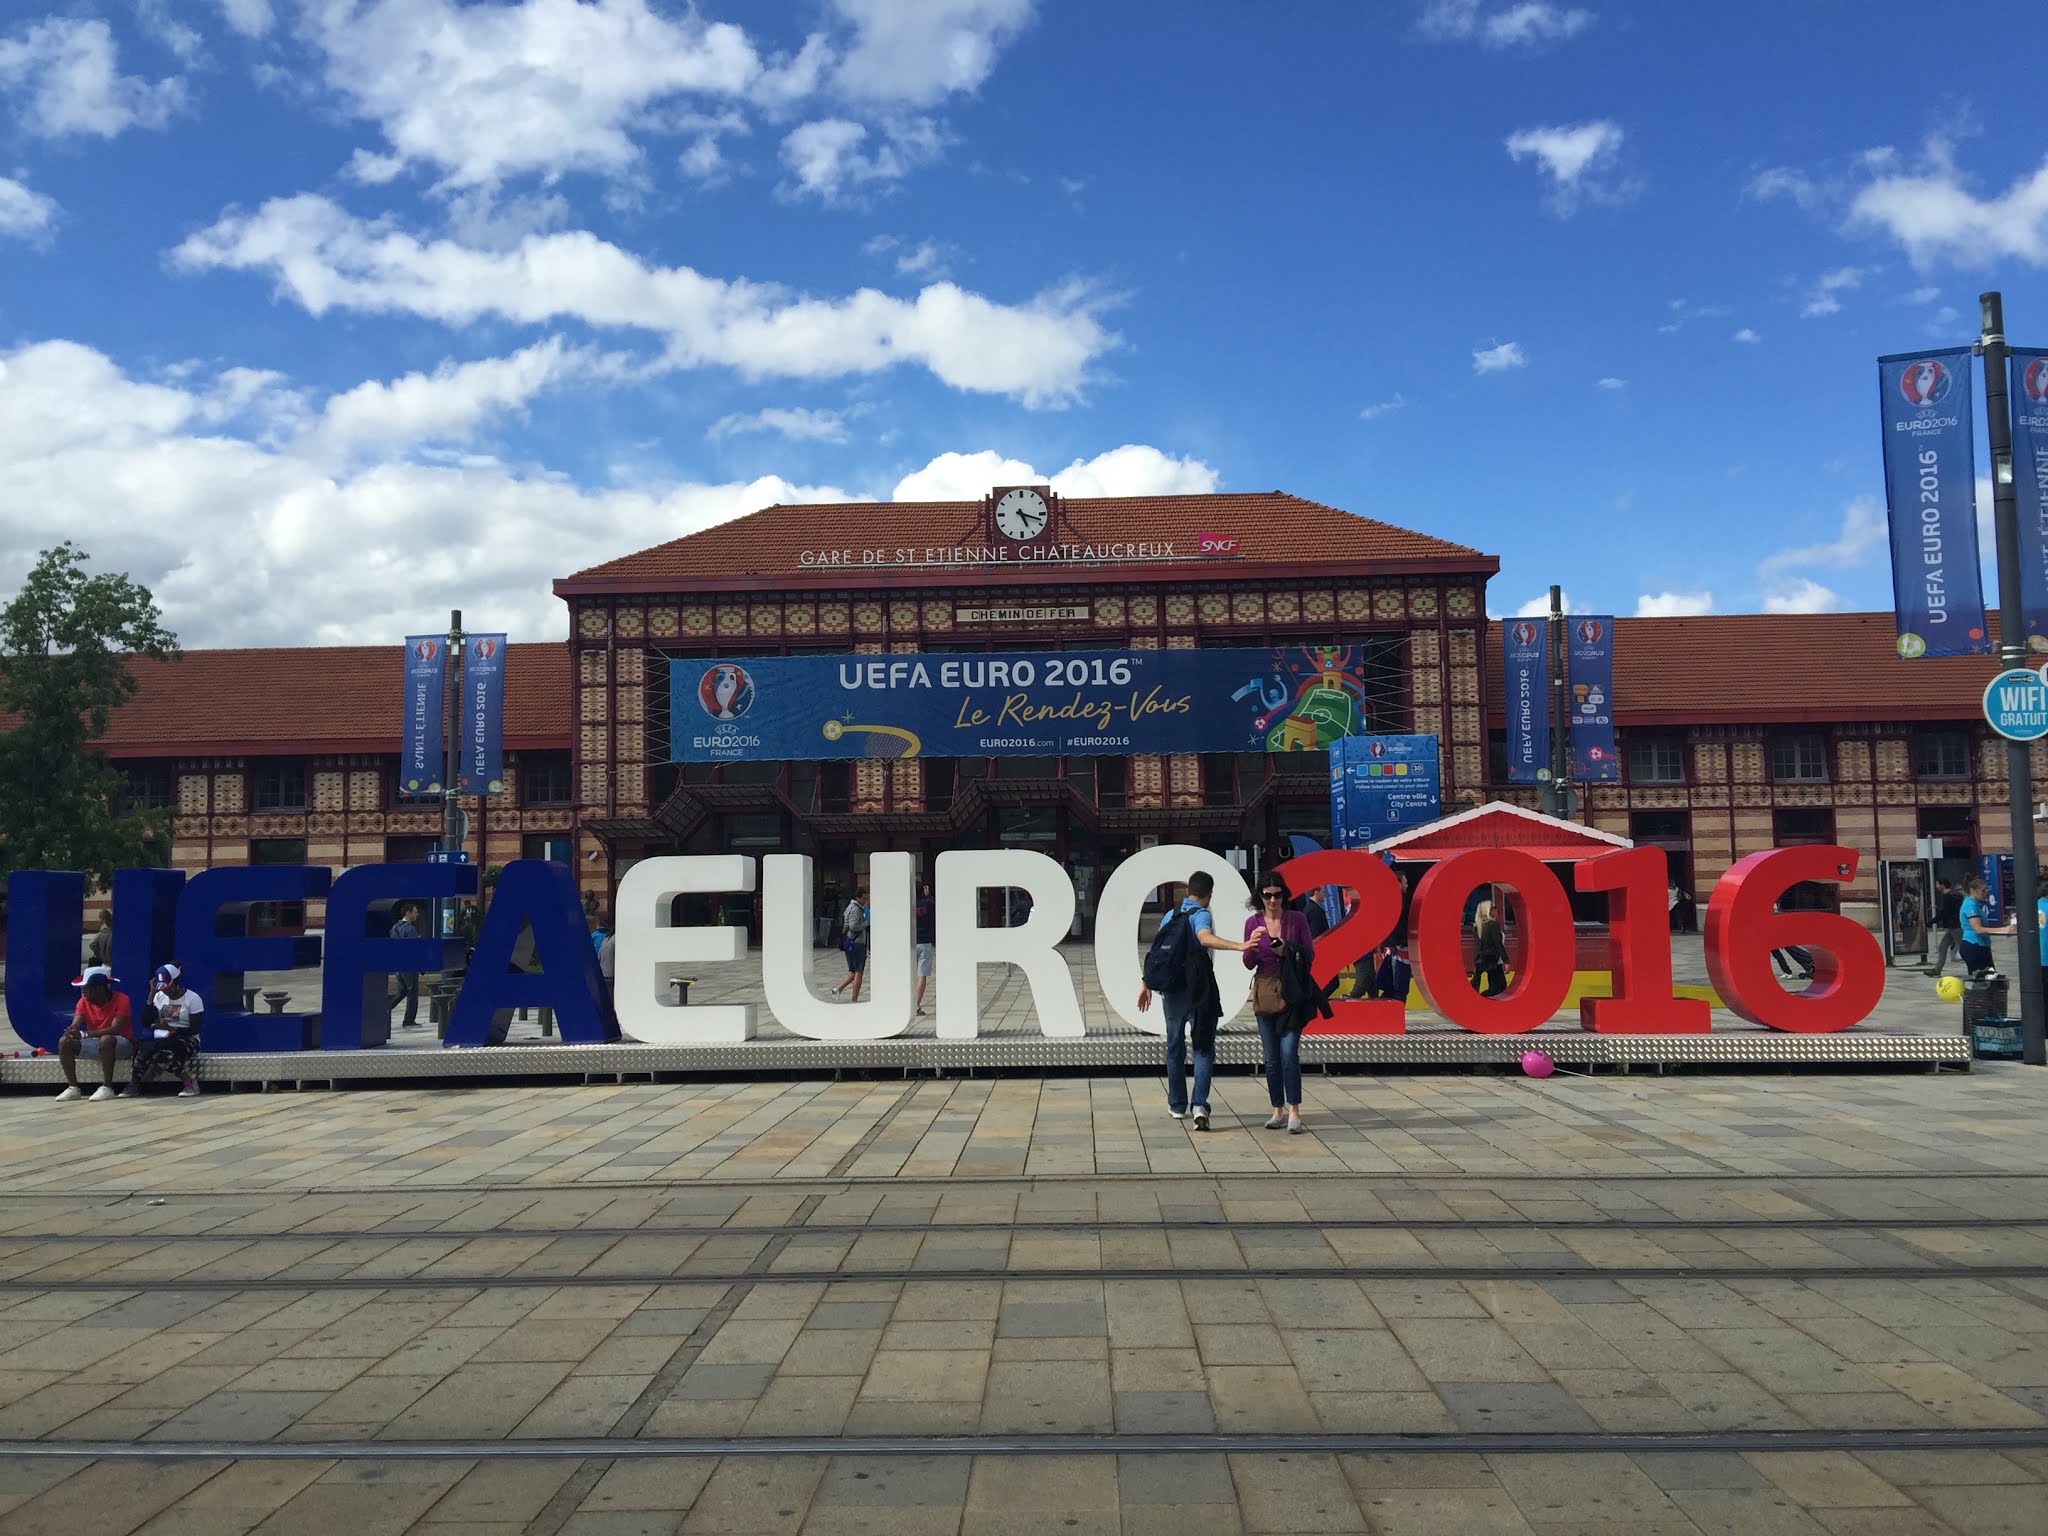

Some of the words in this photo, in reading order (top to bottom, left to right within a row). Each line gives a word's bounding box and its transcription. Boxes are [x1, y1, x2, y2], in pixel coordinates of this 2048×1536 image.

[1896, 416, 1958, 432] EURO2016
[1919, 450, 1938, 503] 2016
[1200, 540, 1238, 552] SNCF
[1922, 508, 1942, 564] EURO
[800, 550, 852, 565] GARE
[862, 549, 886, 564] DE
[895, 548, 916, 563] ST
[925, 547, 1008, 562] ETIENNE
[1018, 542, 1174, 560] CHATEAUCREUX
[1926, 568, 1948, 624] UEFA
[971, 609, 1022, 620] CHEMIN
[1026, 608, 1044, 620] DE
[1049, 608, 1076, 618] FER
[840, 662, 932, 689] UEFA
[940, 661, 1035, 688] EURO
[954, 696, 990, 728] Le
[997, 685, 1191, 730] Rendez-Vous
[2000, 686, 2046, 712] WIFI
[716, 726, 737, 734] UEFA
[2000, 712, 2048, 726] GRATUIT
[694, 736, 760, 748] EURO2016
[980, 738, 1054, 748] EURO2016.com
[1067, 736, 1130, 747] #EURO2016
[6, 860, 621, 1054] UEFA
[614, 844, 1256, 1043] EURO
[1272, 845, 1886, 1034] 2016
